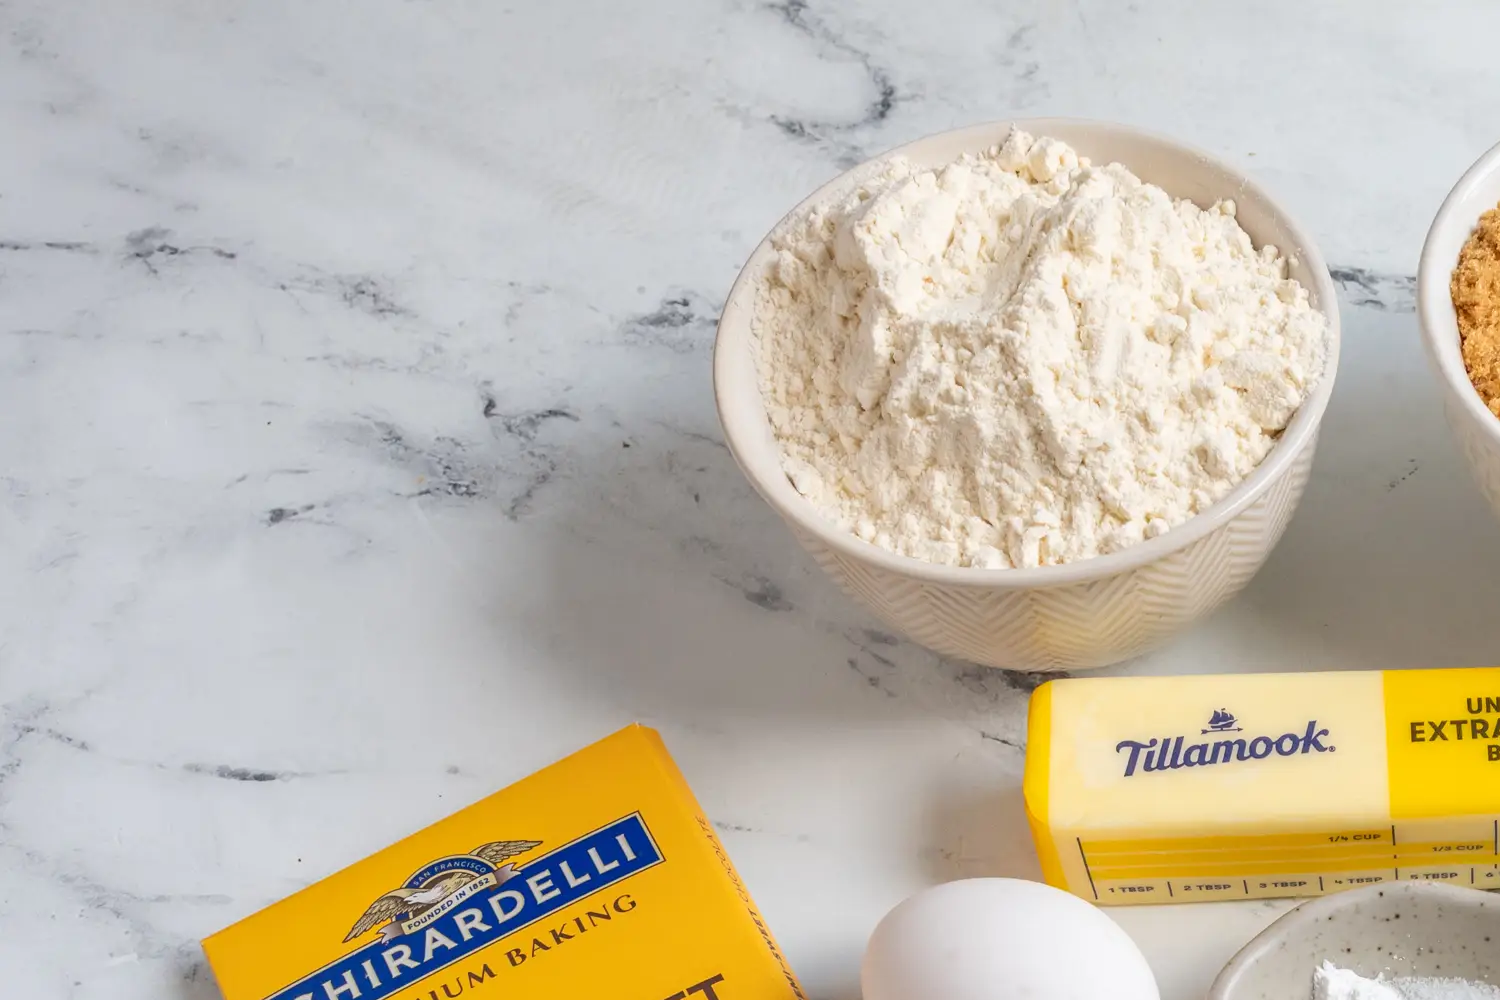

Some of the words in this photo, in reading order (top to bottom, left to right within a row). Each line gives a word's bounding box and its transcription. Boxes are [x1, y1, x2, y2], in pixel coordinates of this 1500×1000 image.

[1116, 720, 1329, 777] Tillamook
[1328, 835, 1349, 843] 1/4
[1352, 833, 1381, 841] CUP
[413, 871, 431, 886] SAN
[434, 861, 487, 874] FRANCISCO
[1422, 871, 1458, 879] TBSP
[1259, 881, 1268, 889] 3
[1271, 880, 1307, 888] TBSP
[1347, 876, 1383, 884] TBSP
[1118, 885, 1155, 893] TBSP
[1195, 883, 1232, 891] TBSP
[407, 900, 454, 930] FOUNDED
[455, 890, 467, 901] IN
[468, 877, 490, 891] 1852
[506, 894, 638, 968] BAKING
